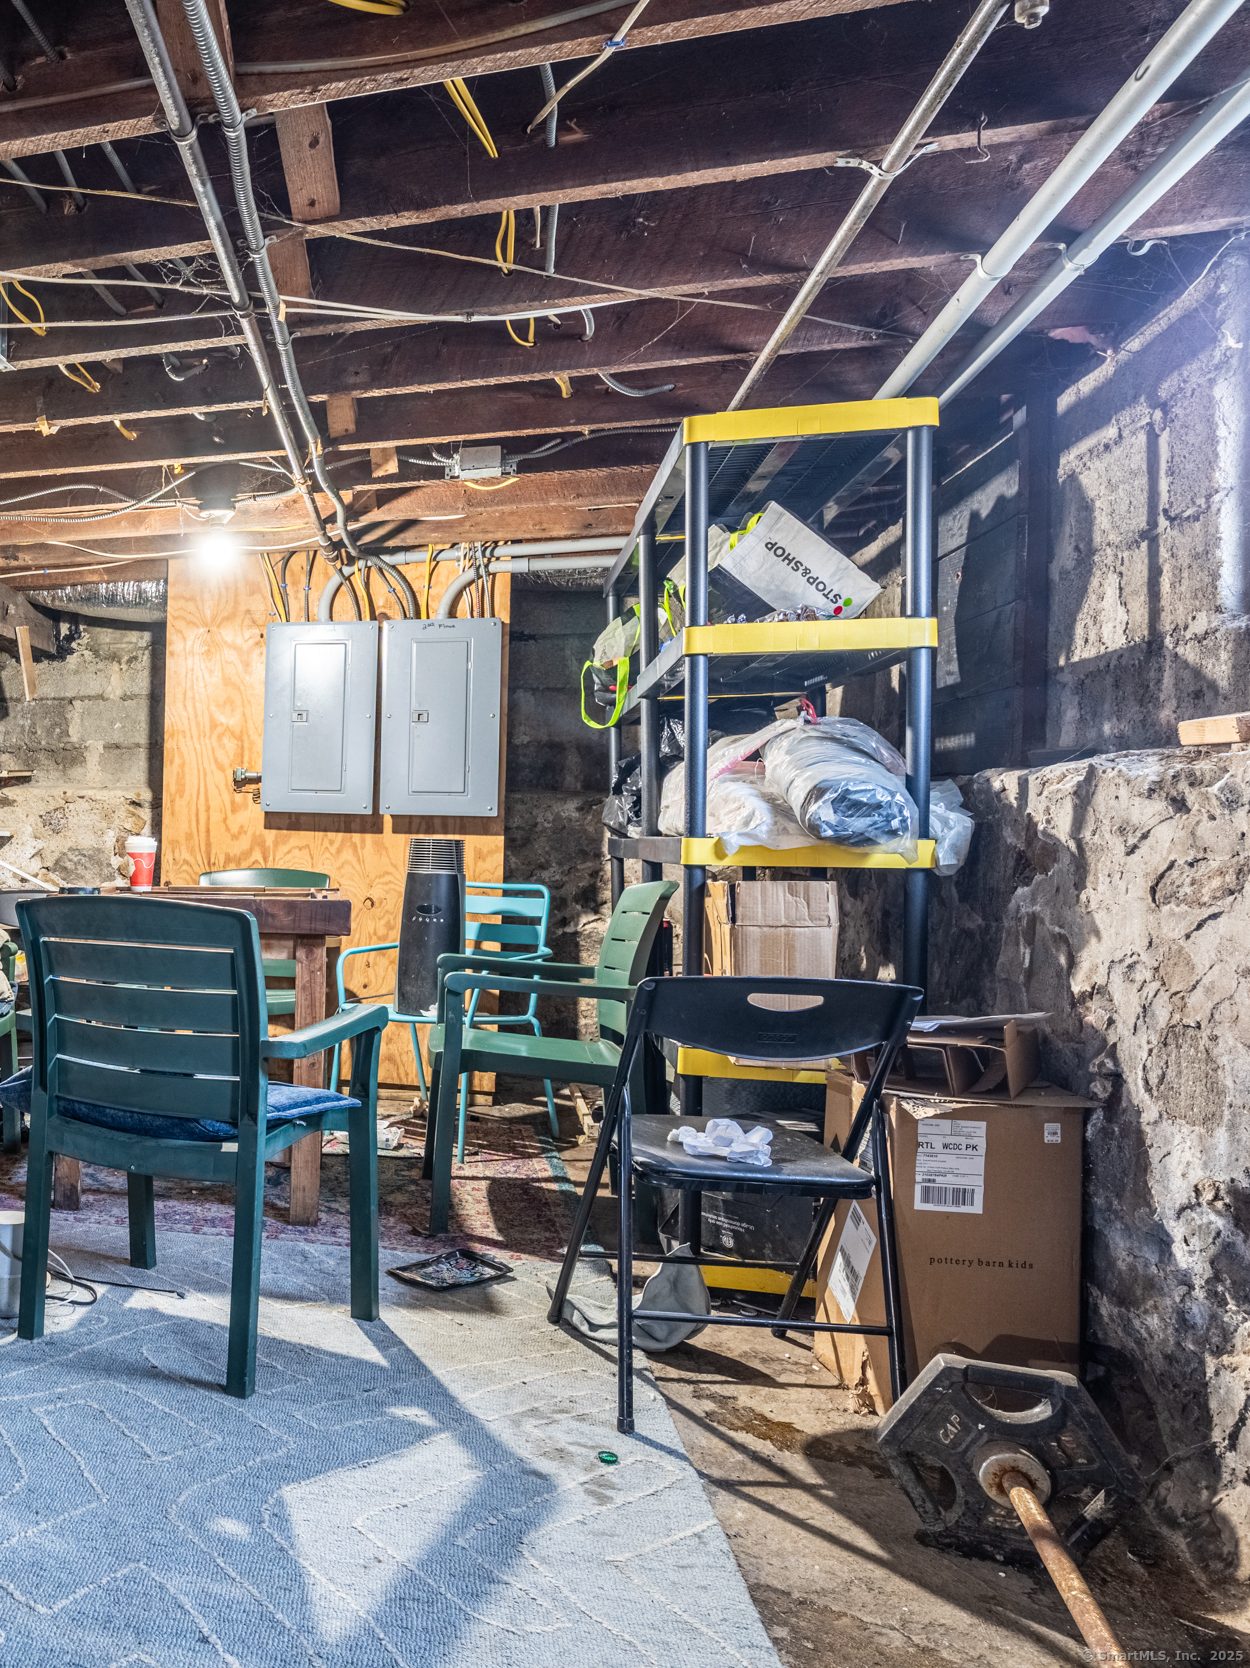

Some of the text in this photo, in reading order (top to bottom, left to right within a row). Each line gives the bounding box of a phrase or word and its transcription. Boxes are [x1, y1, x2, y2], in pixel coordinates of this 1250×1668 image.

[764, 540, 843, 605] STOP&SHOP
[918, 1141, 979, 1152] RTL WCDC PK
[929, 1257, 1034, 1270] pottery barn kids
[939, 1414, 962, 1445] CAP
